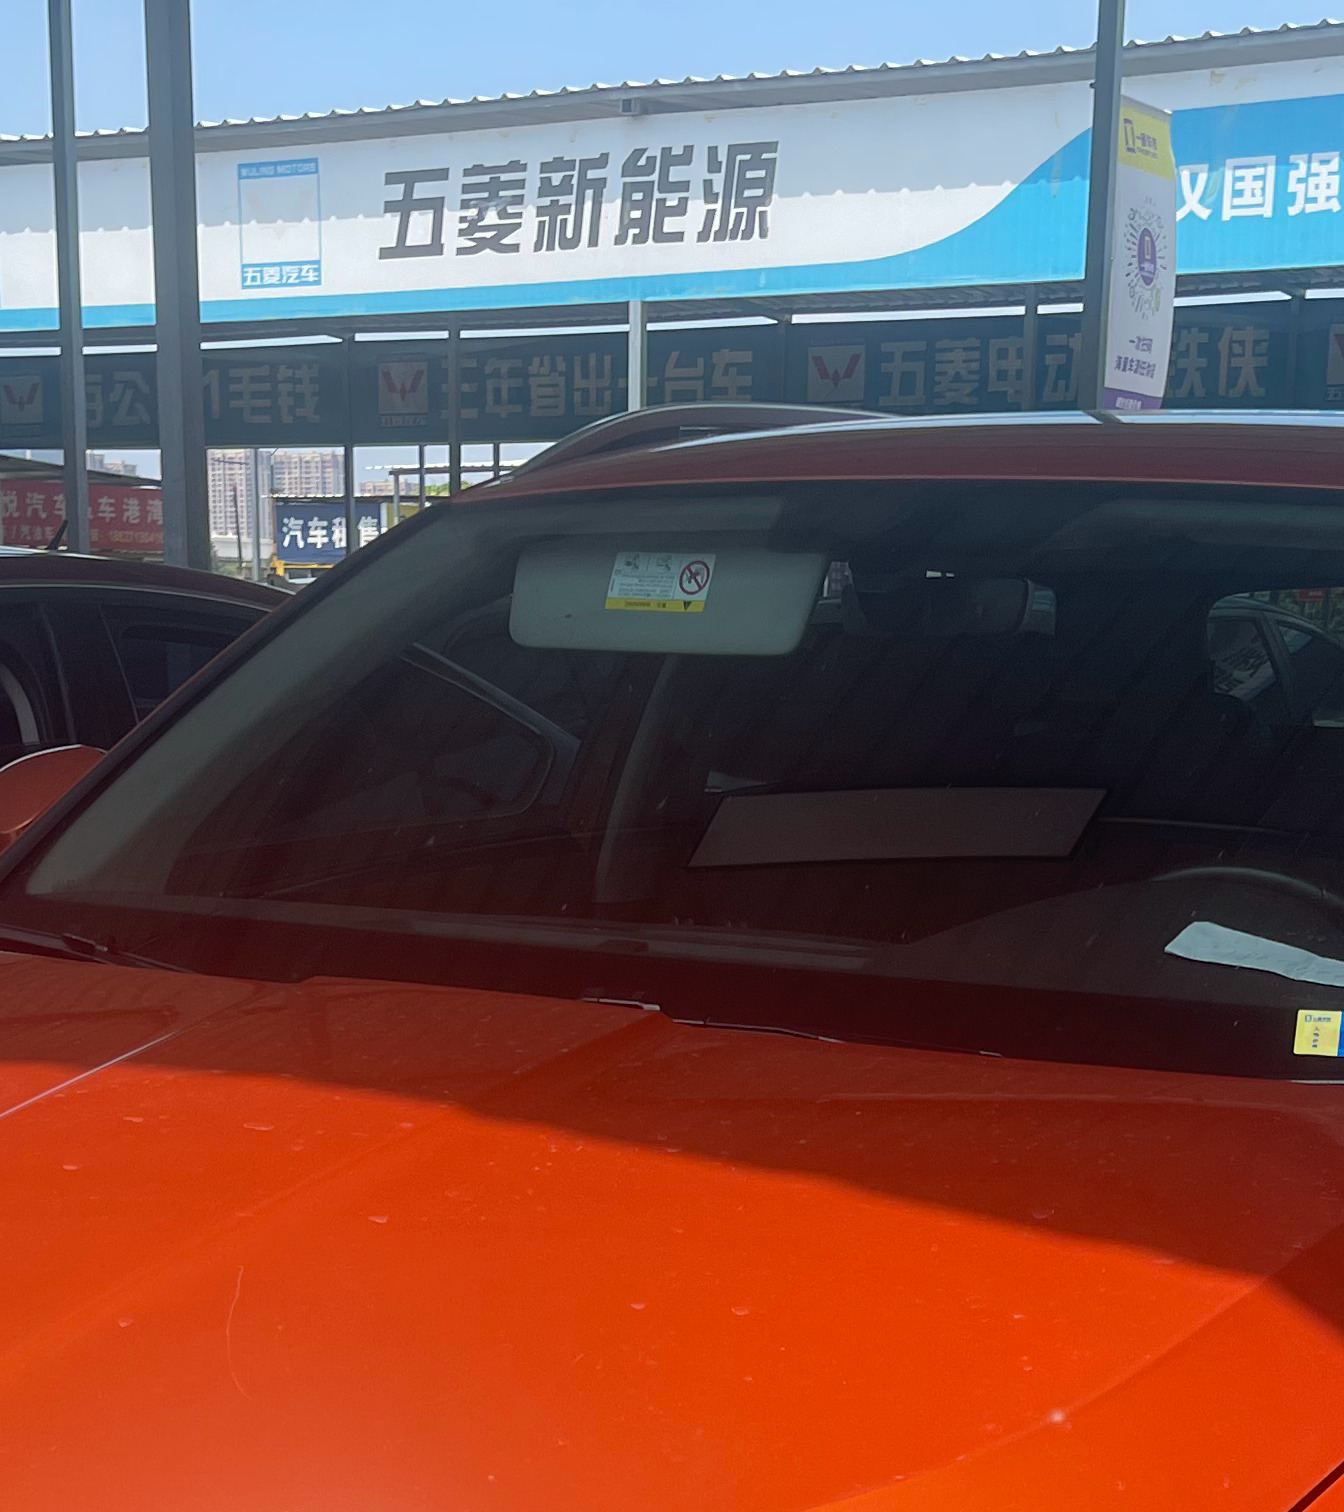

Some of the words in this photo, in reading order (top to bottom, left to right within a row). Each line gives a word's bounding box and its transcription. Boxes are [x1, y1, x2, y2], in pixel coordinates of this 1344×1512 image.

[378, 140, 779, 260] 五菱新能源
[243, 264, 319, 286] 五菱汽车
